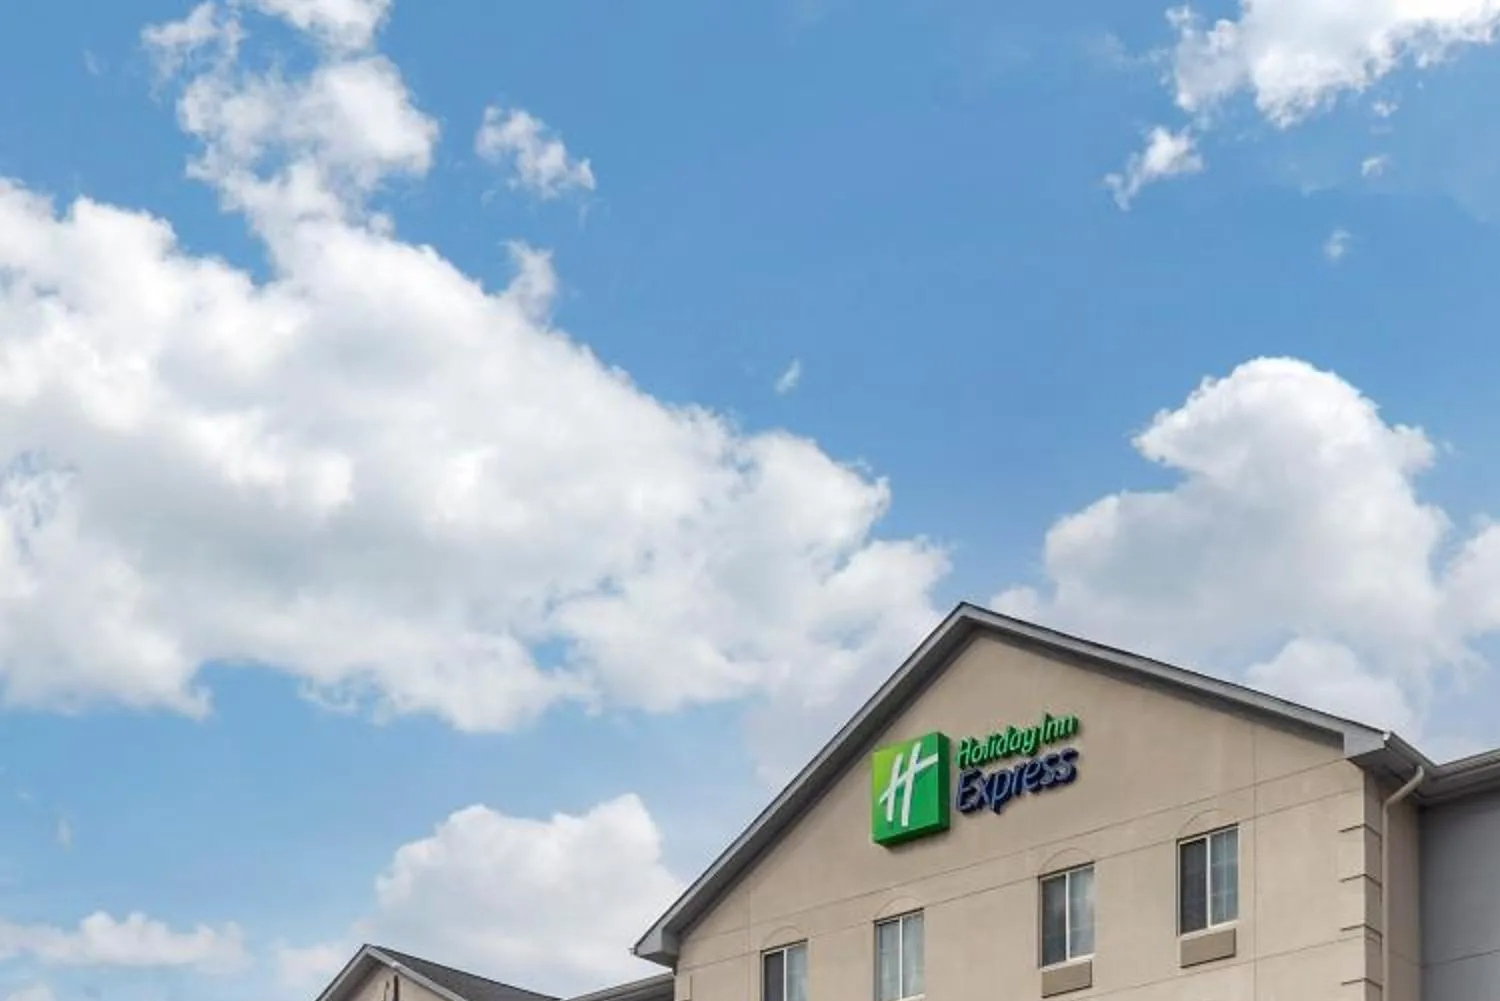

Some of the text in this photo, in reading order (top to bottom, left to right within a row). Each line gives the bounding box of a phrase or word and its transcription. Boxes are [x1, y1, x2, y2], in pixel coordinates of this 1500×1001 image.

[956, 713, 1079, 769] Holiday Inn
[956, 747, 1079, 814] Express
